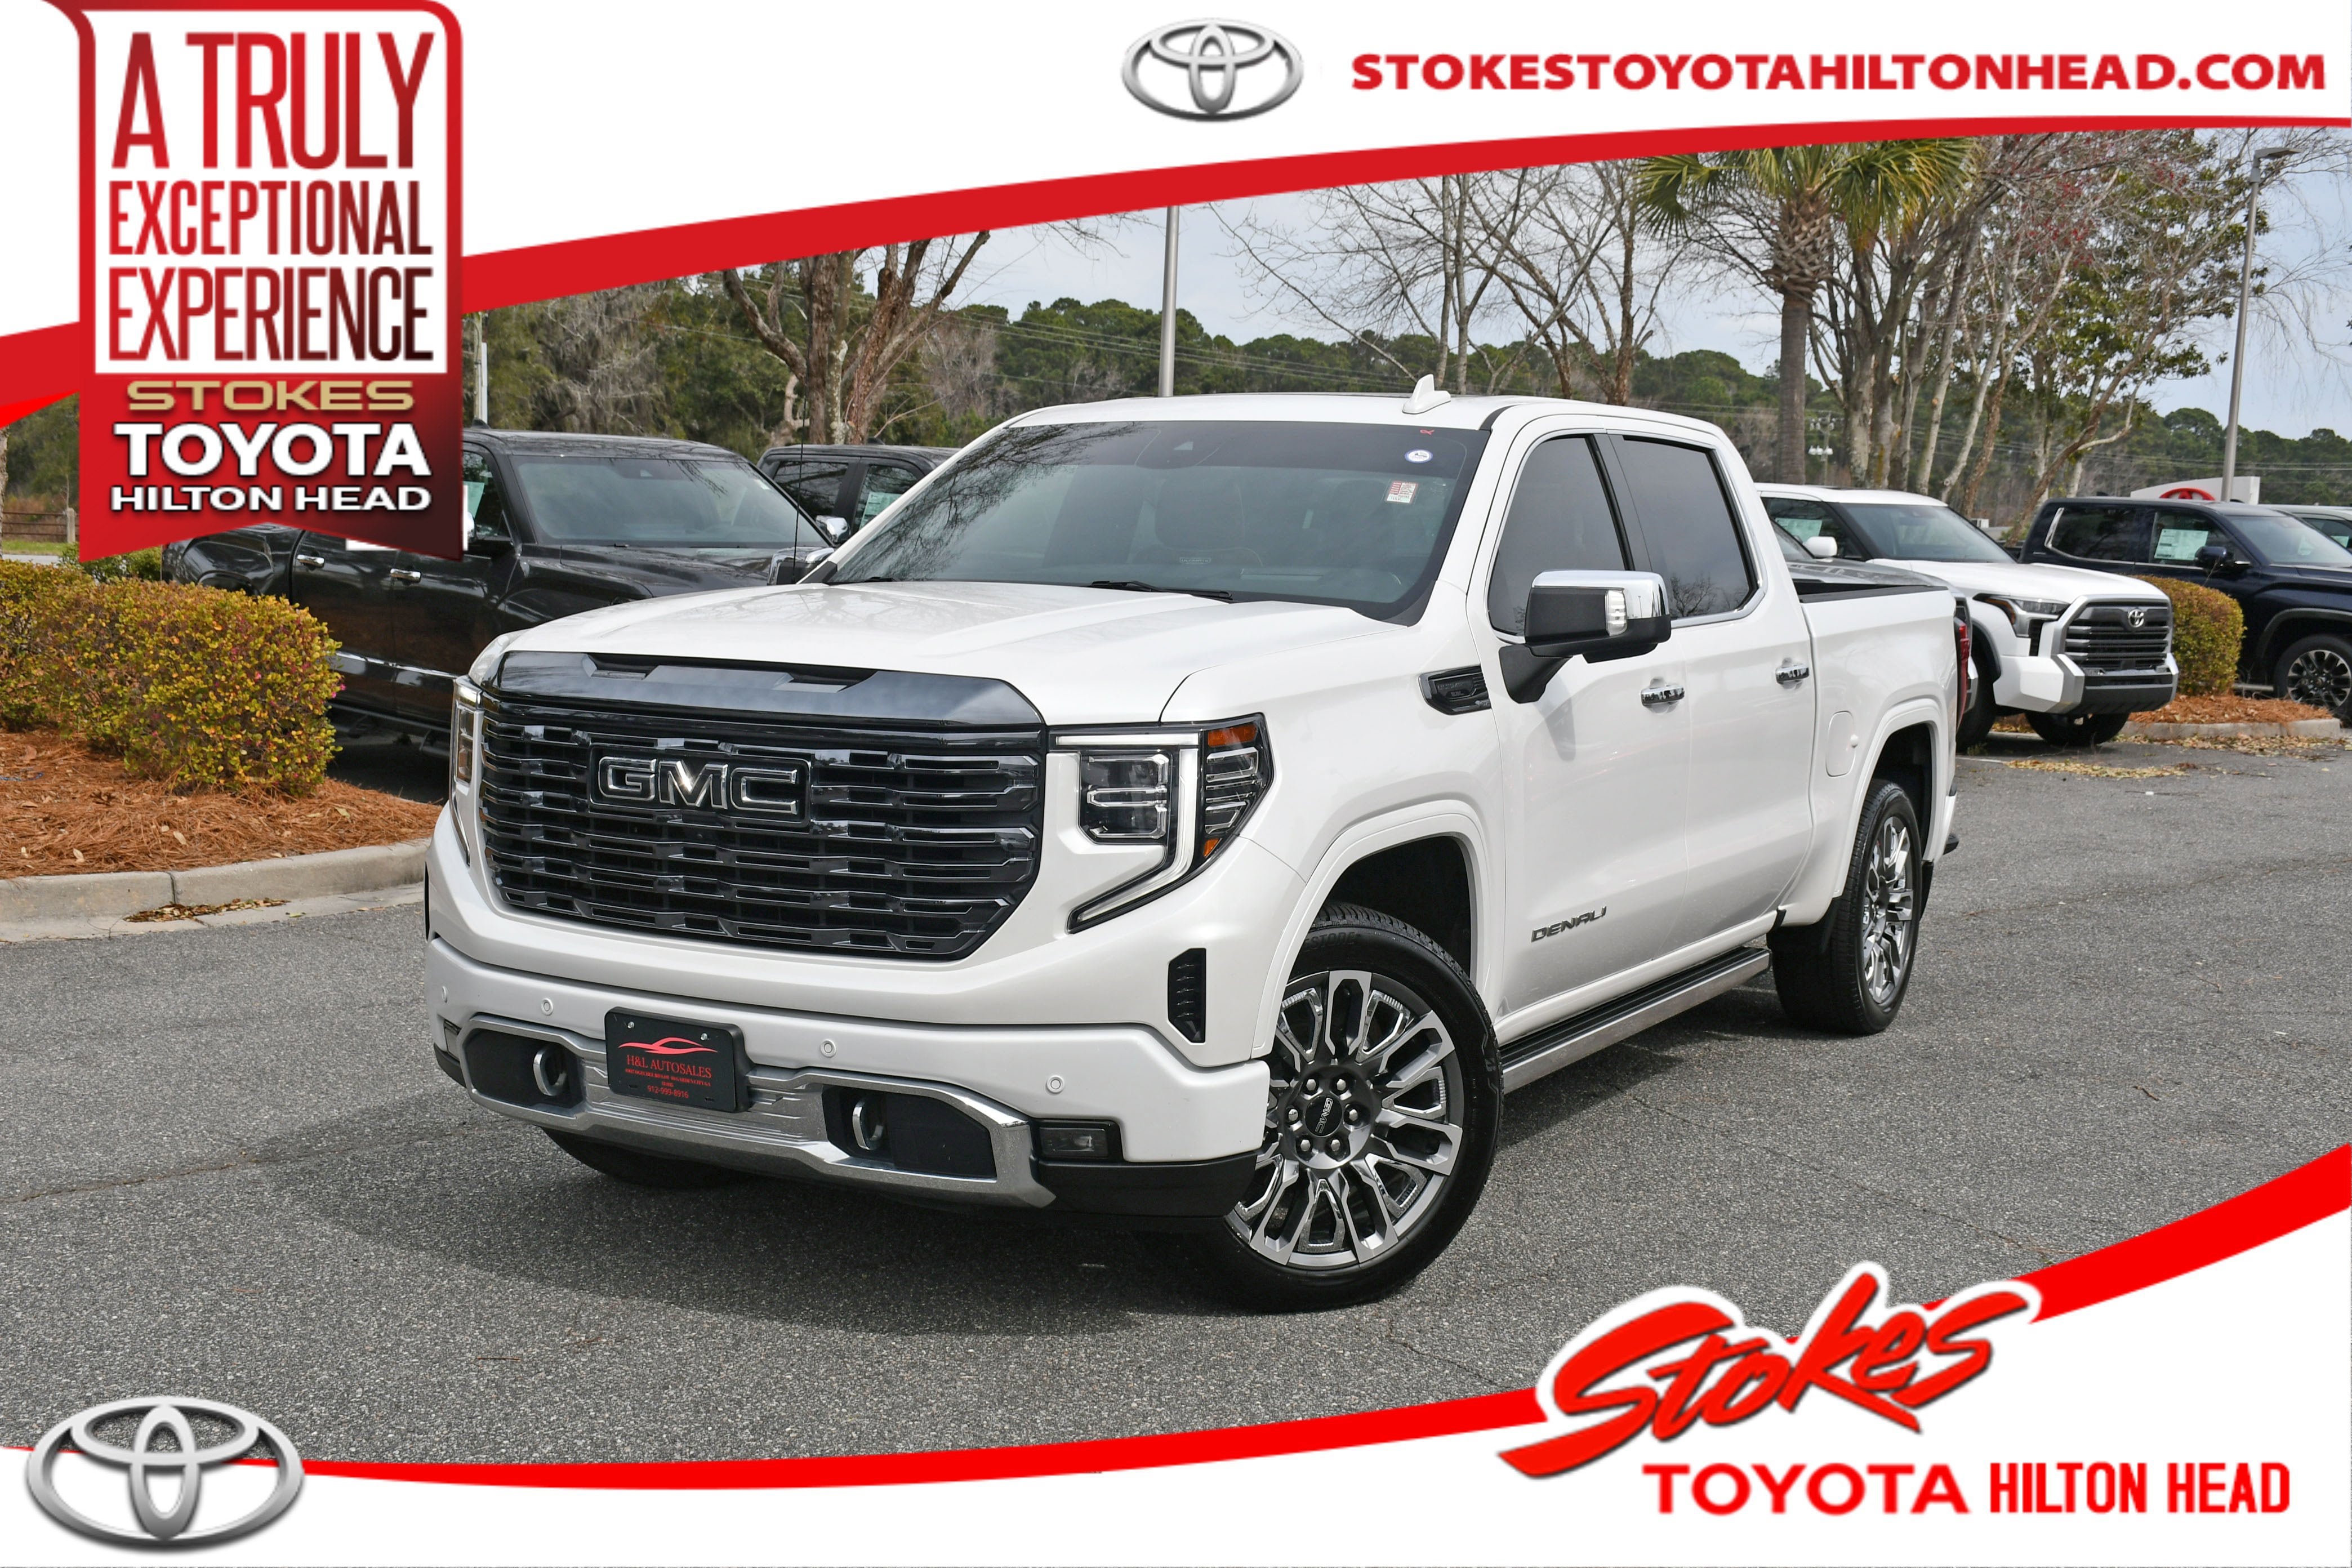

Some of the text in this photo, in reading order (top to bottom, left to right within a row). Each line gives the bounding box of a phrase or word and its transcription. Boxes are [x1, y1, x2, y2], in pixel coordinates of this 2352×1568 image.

[598, 756, 797, 815] GMC
[1531, 906, 1607, 942] DENALI
[627, 1055, 647, 1068] H&L
[651, 1059, 711, 1078] AUTOSALES
[1315, 1097, 1333, 1133] GMC
